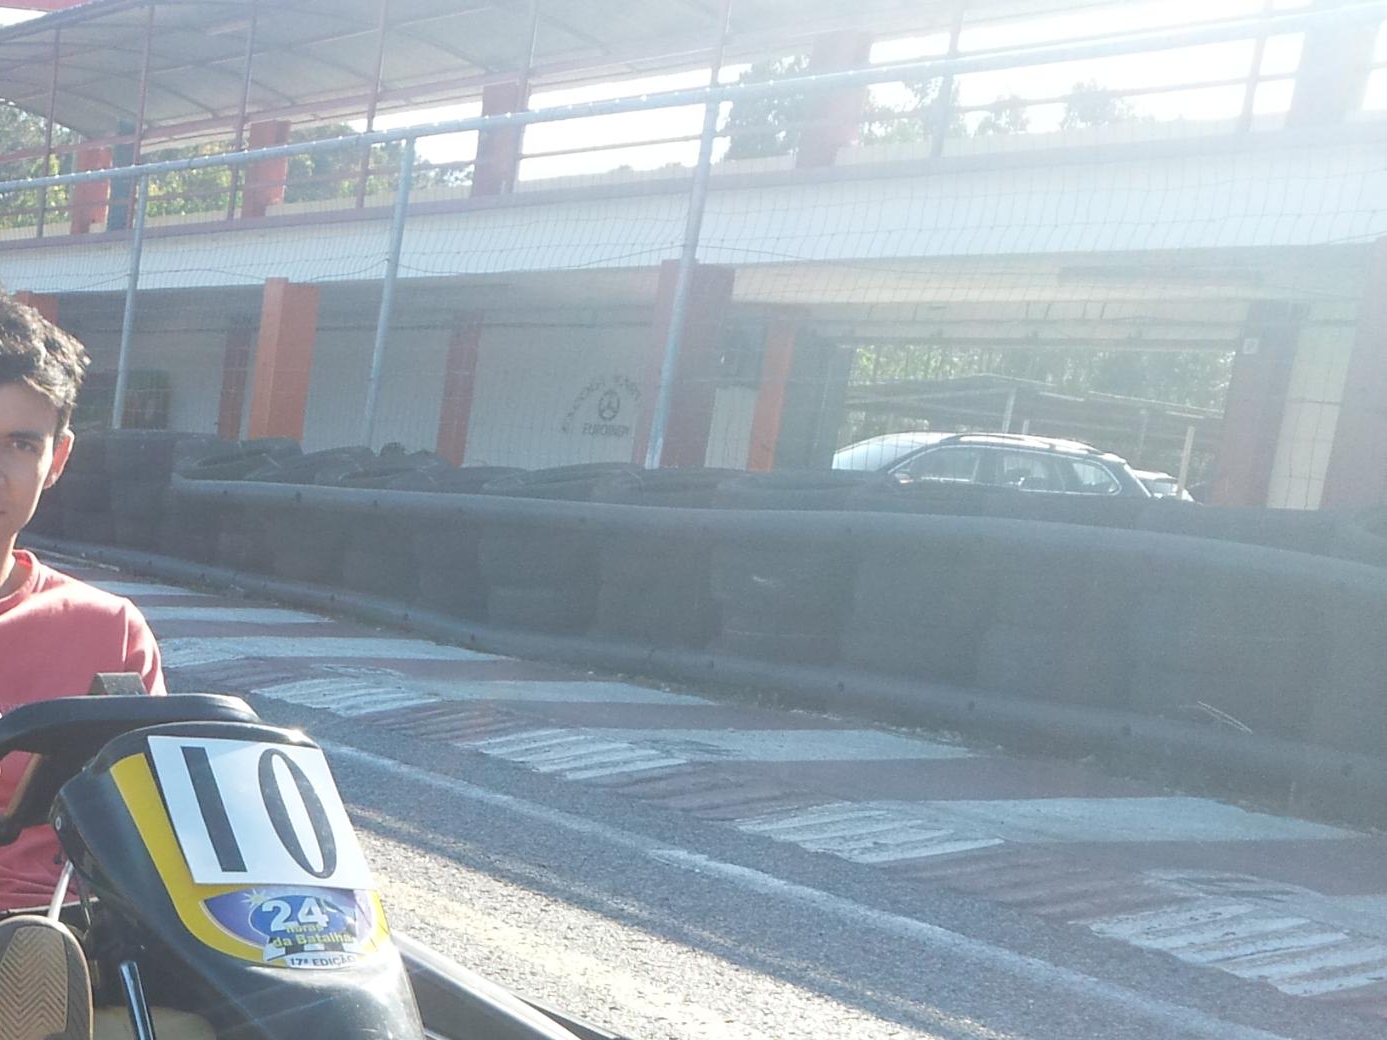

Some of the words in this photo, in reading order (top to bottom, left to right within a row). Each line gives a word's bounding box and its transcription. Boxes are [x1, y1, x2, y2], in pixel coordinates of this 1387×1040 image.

[180, 745, 338, 880] 10
[261, 896, 330, 932] 24
[272, 936, 293, 949] da
[296, 931, 354, 946] Batalha
[313, 954, 357, 968] EDIÇÃO
